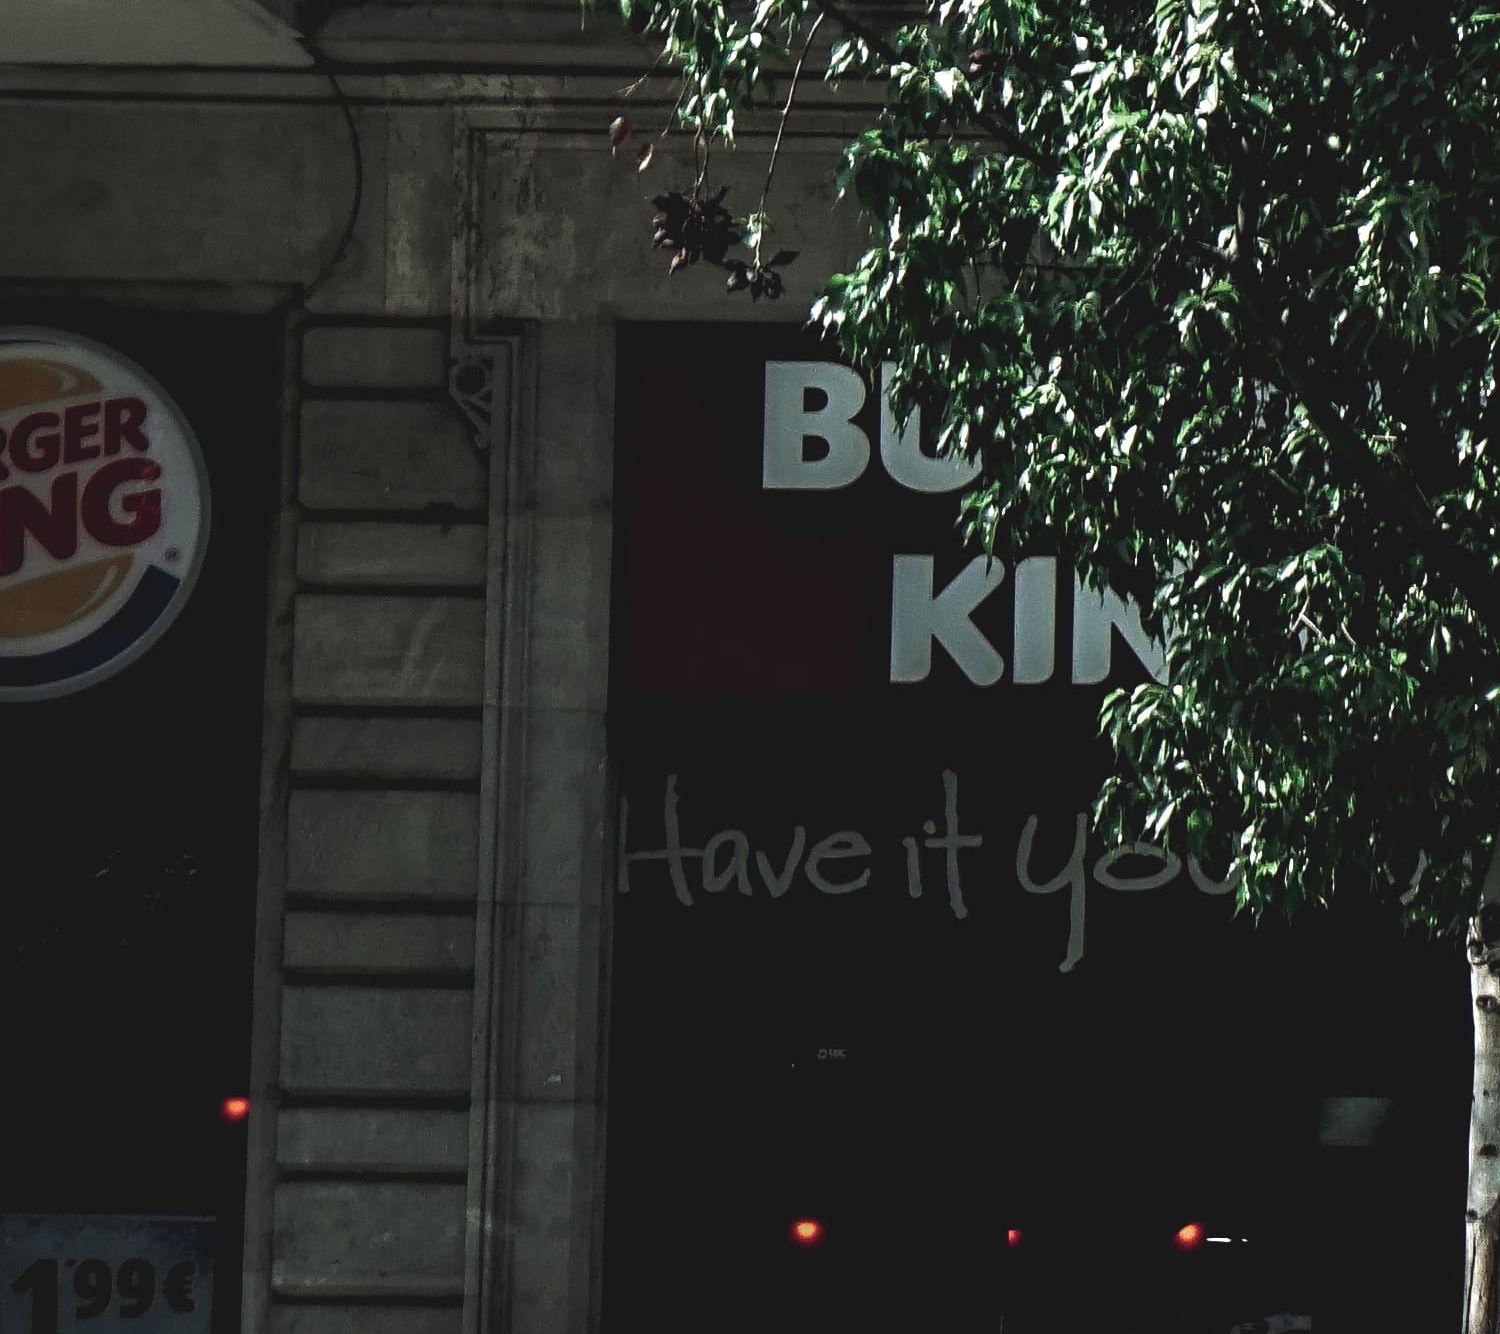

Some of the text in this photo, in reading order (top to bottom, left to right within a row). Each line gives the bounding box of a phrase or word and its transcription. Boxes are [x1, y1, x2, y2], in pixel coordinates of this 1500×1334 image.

[889, 552, 1172, 686] KIN
[616, 768, 1245, 973] Have it you
